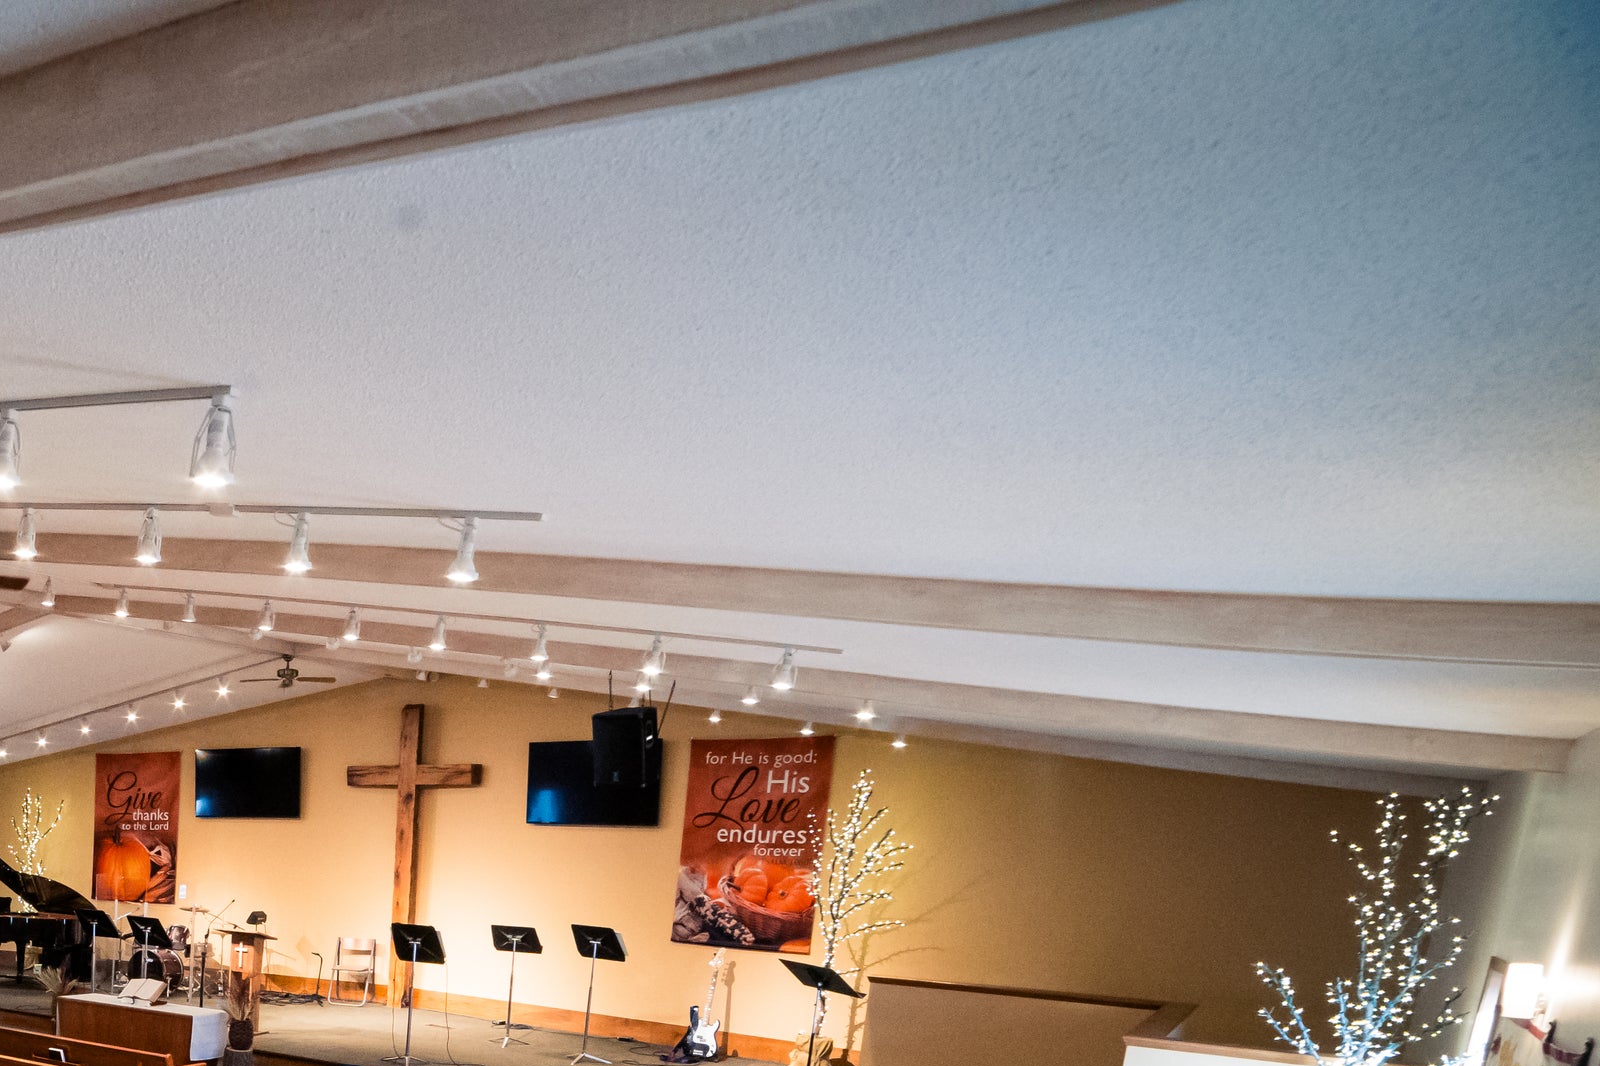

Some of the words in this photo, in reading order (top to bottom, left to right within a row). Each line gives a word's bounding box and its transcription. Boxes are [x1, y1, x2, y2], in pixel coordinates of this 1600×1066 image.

[705, 751, 727, 764] for
[732, 752, 753, 764] He
[758, 752, 769, 764] is
[773, 749, 818, 768] good;
[766, 769, 810, 793] His
[104, 771, 163, 826] Give
[692, 766, 800, 828] Love
[132, 809, 169, 820] thanks
[134, 822, 147, 830] the
[149, 822, 169, 830] Lord
[717, 823, 807, 844] endures
[753, 844, 805, 857] forever
